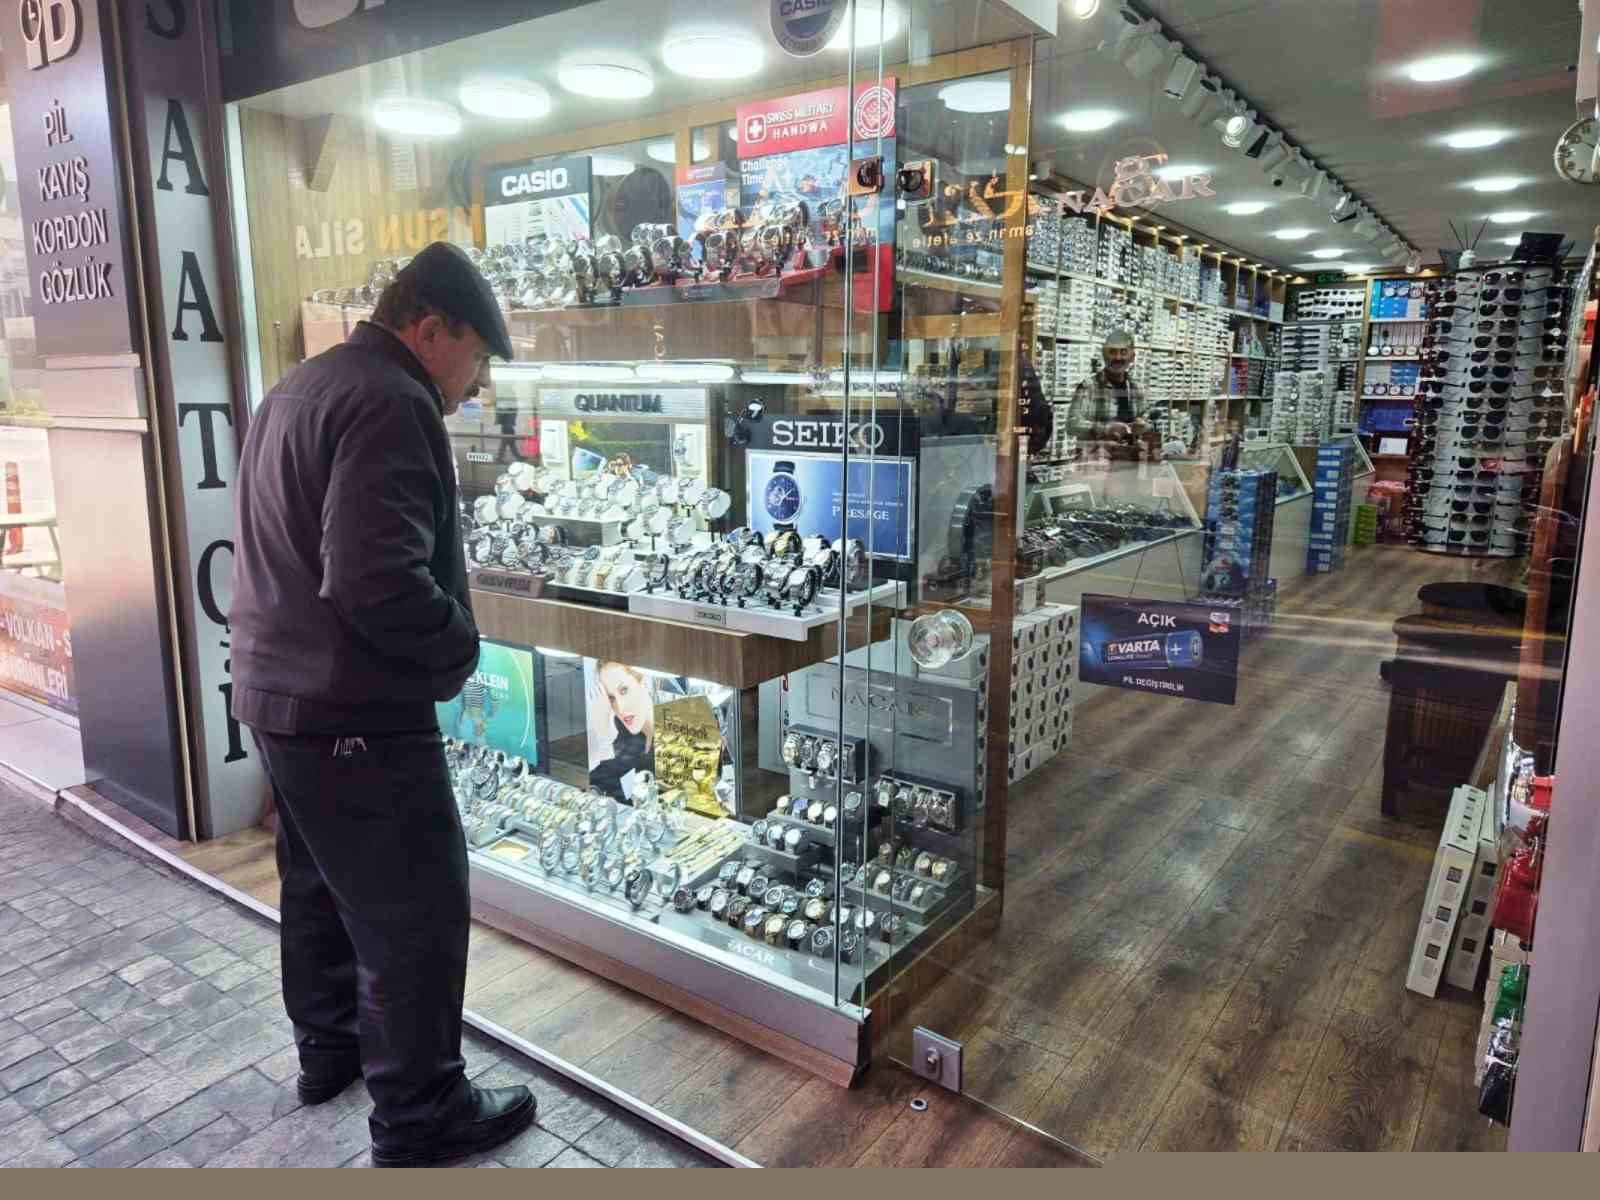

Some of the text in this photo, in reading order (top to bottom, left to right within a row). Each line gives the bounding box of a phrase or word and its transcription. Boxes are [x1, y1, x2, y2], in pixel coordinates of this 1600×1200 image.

[41, 99, 73, 147] PİL
[766, 110, 793, 124] SWISS
[38, 155, 89, 204] KAYIŞ
[501, 167, 568, 197] CASIO
[32, 208, 108, 256] KORDON
[40, 255, 113, 305] GÖZLÜK
[574, 393, 663, 413] QUANTUM
[772, 420, 885, 449] SEIKO
[1137, 612, 1177, 628] AÇIK
[1118, 639, 1161, 655] VARTA
